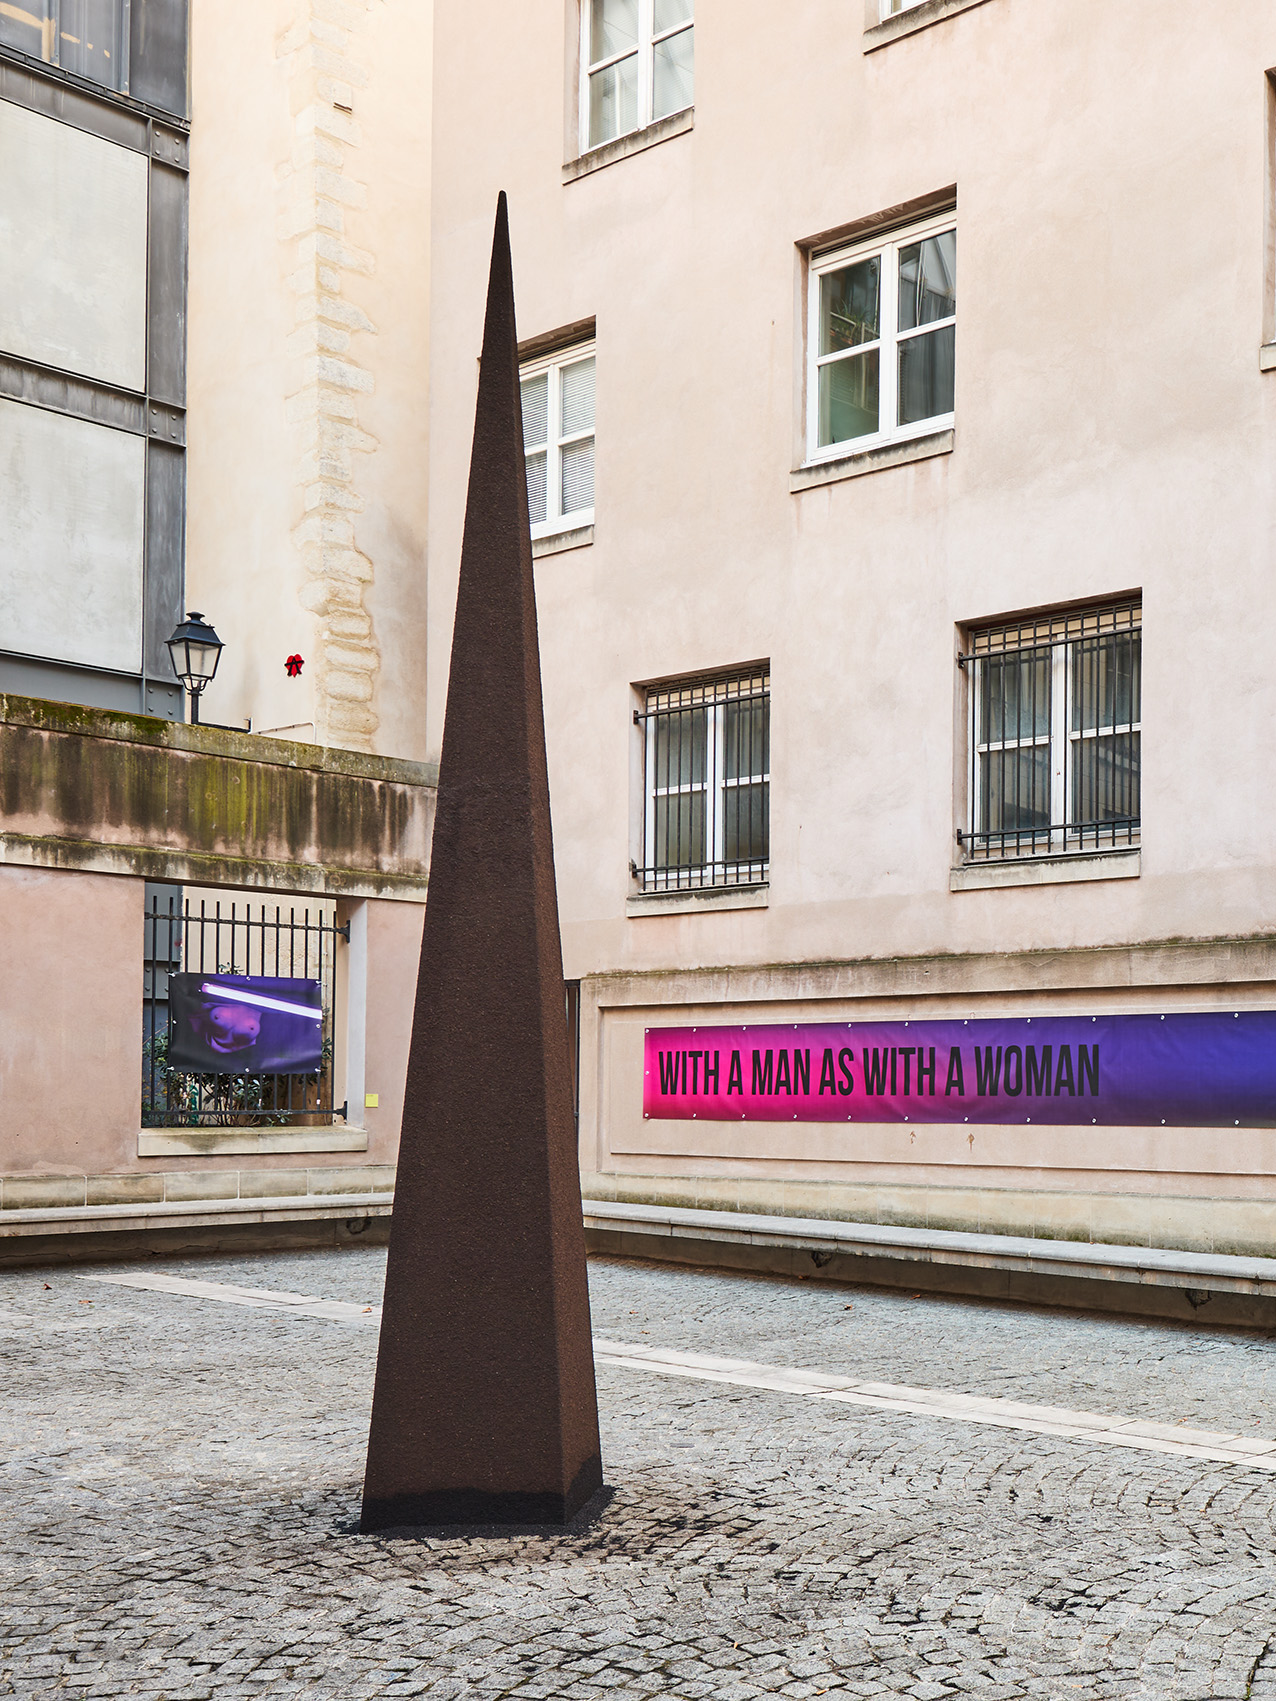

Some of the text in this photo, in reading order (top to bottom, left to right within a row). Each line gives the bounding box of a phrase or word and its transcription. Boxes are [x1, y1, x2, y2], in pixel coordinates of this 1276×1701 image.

[658, 1044, 1099, 1097] WITH A MAN AS WITH A WOMAN
